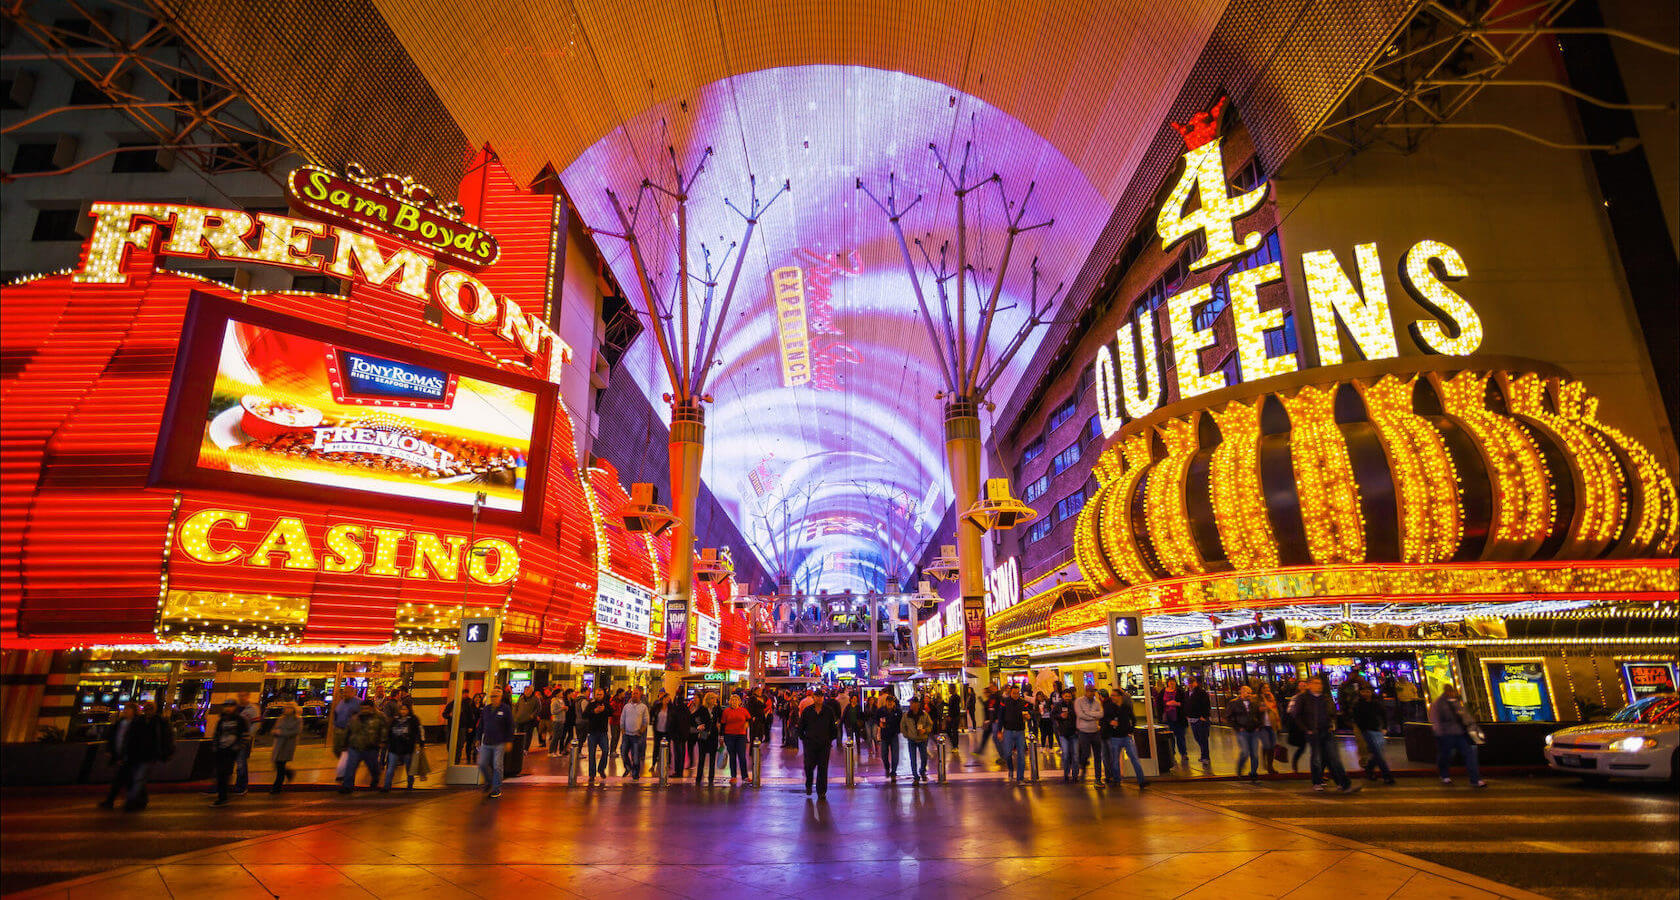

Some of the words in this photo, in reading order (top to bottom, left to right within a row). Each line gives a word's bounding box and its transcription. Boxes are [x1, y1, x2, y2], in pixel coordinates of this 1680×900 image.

[303, 171, 389, 223] Sam
[393, 206, 492, 259] Boyd's
[1156, 136, 1269, 272] 4
[72, 202, 573, 384] FREMONT
[778, 268, 807, 382] EXPERIENCE
[1095, 239, 1484, 440] QUEENS
[351, 371, 370, 381] RIBS
[375, 376, 409, 389] SEAFOOD
[413, 385, 442, 397] STEAKS
[311, 426, 456, 476] FREMONT
[178, 509, 522, 587] CASINO
[985, 556, 1019, 619] ASINO
[964, 608, 985, 621] FLY
